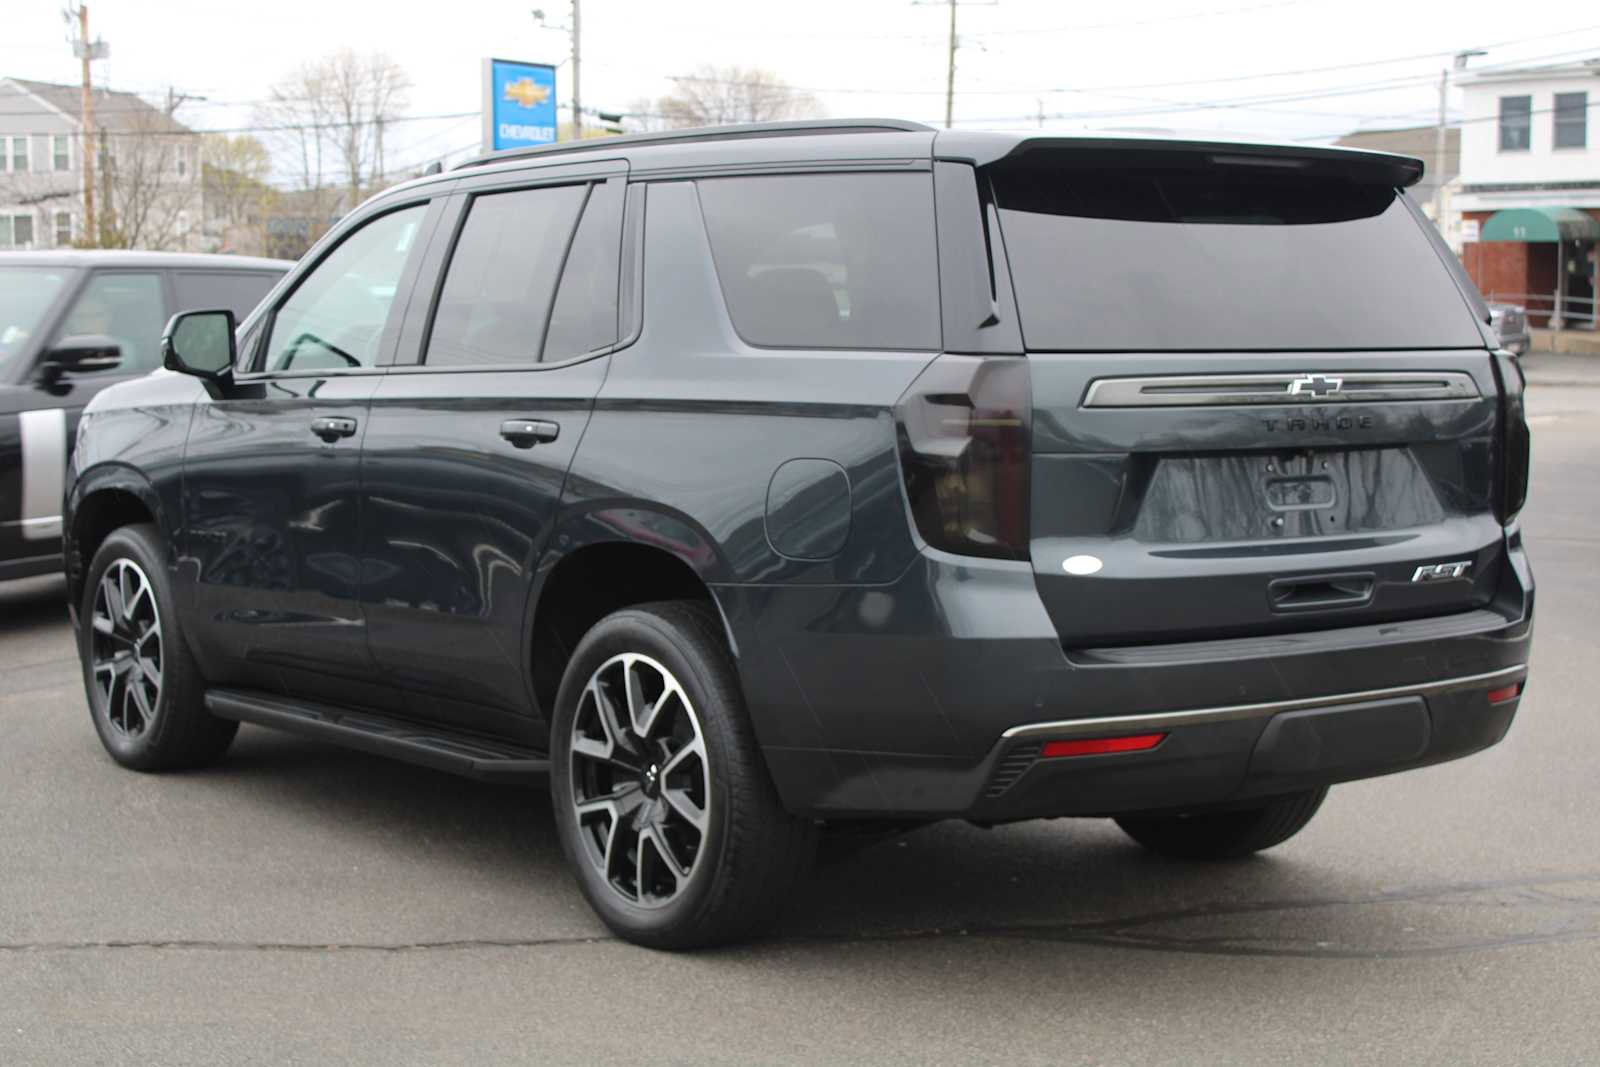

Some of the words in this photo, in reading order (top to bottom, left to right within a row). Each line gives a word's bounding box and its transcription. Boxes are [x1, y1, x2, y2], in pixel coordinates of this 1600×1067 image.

[499, 123, 555, 141] CHEVROLET
[1262, 416, 1373, 432] TAHOE
[1411, 560, 1472, 582] RST
